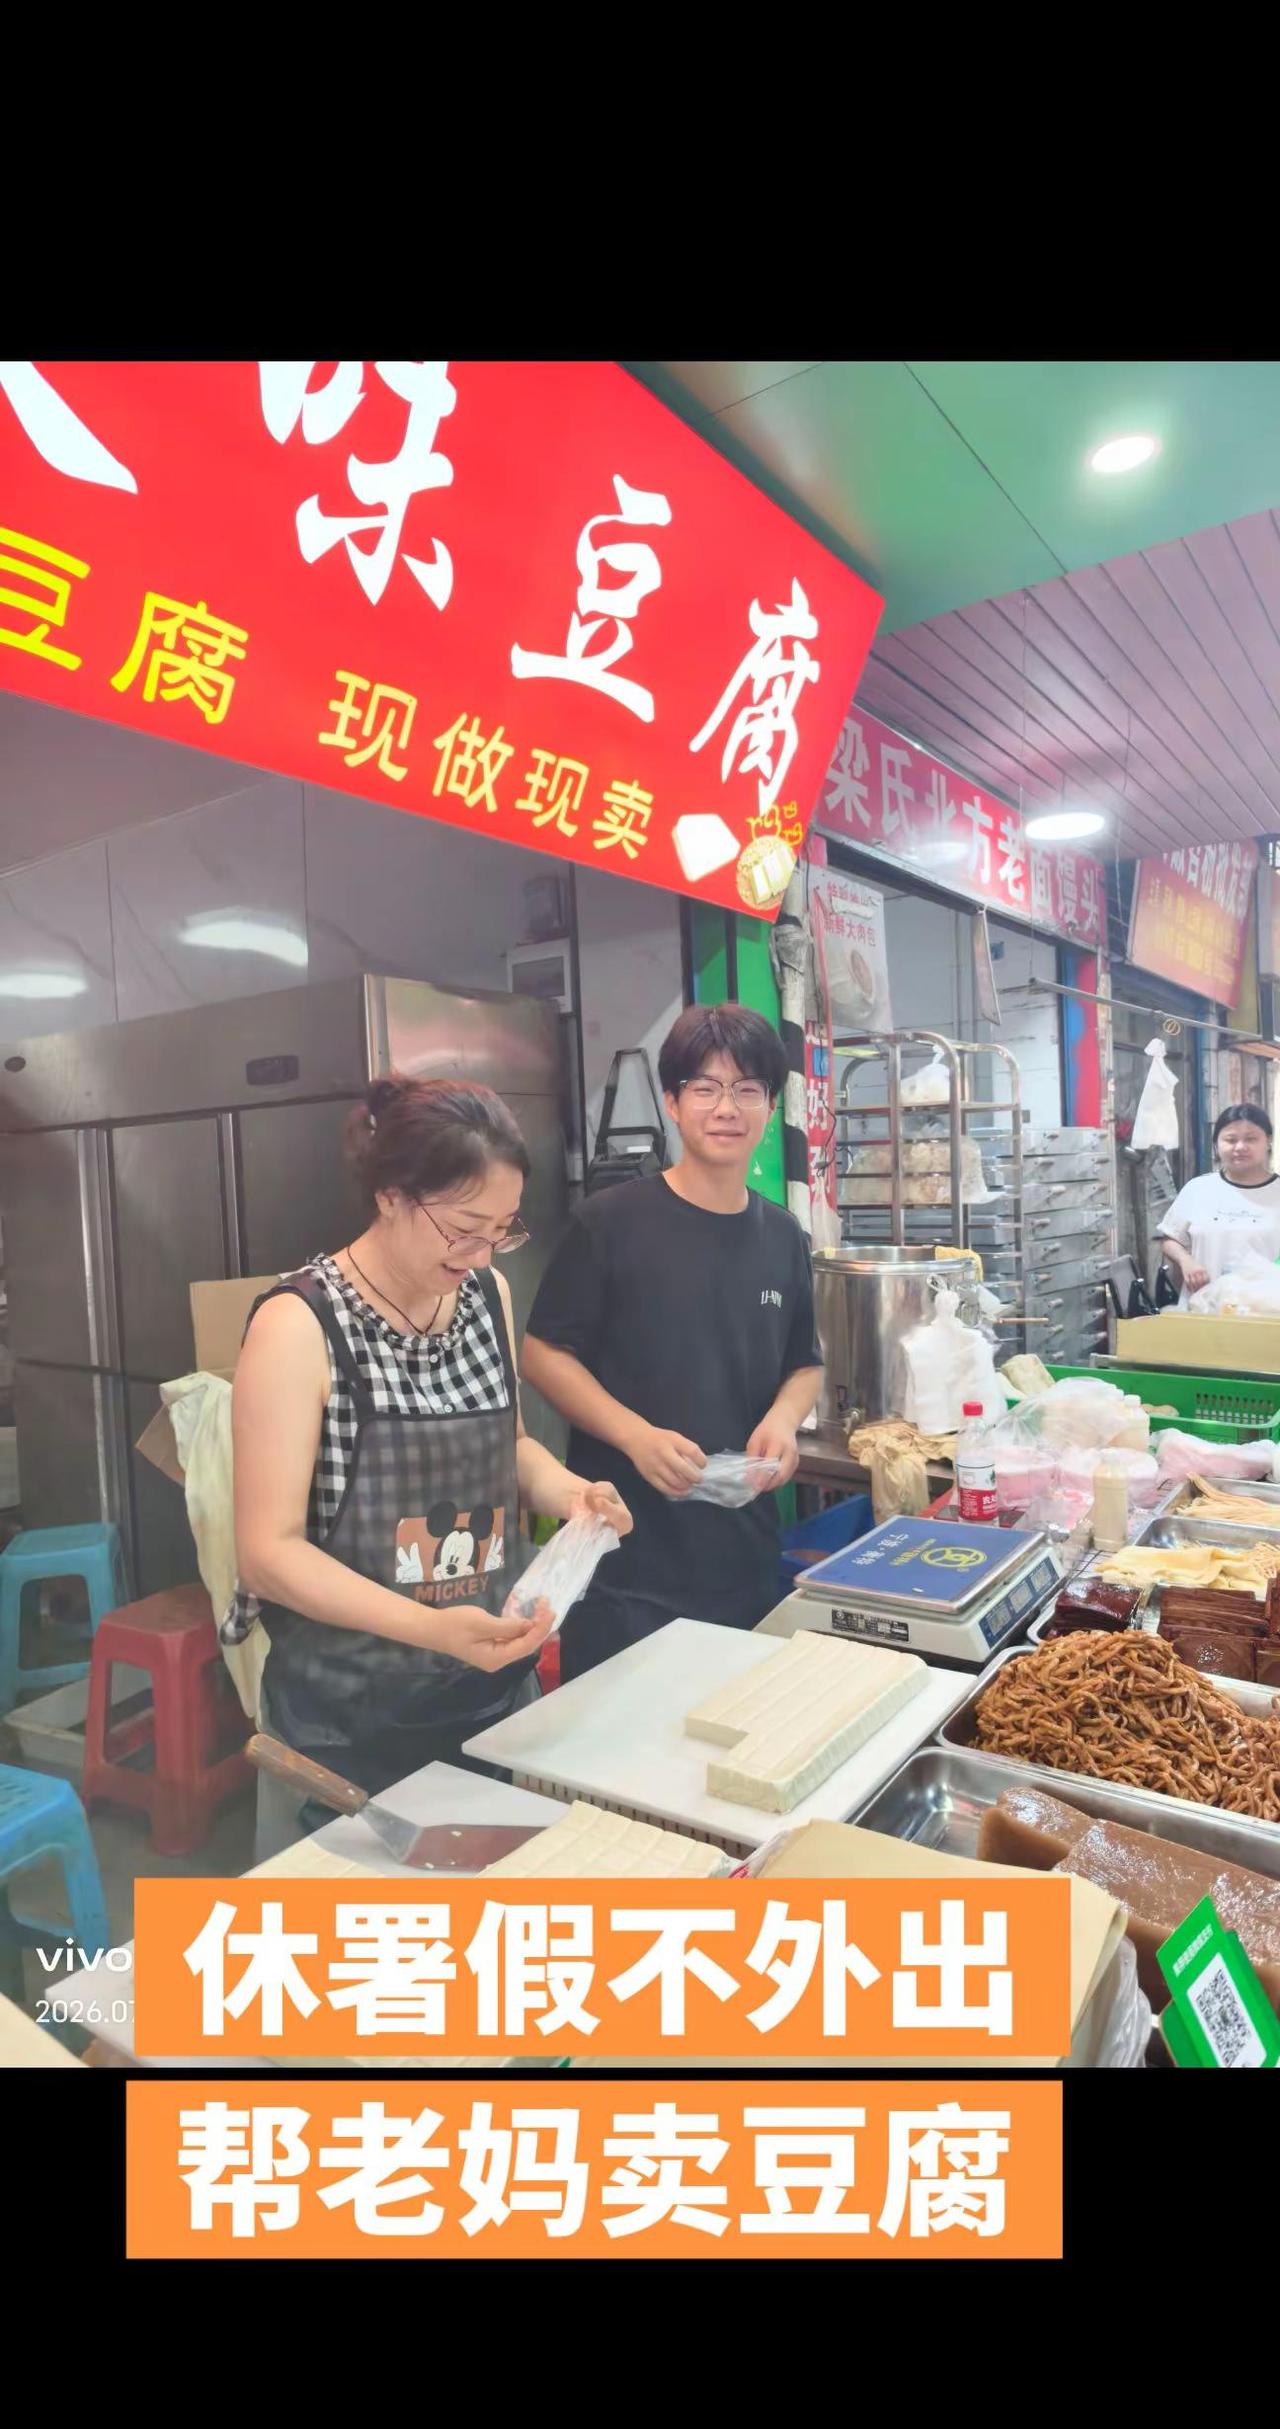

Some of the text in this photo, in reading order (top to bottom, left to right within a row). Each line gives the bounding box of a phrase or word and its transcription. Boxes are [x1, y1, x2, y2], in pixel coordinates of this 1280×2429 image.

[318, 670, 655, 859] 现做现卖
[415, 1575, 489, 1601] MICKEY
